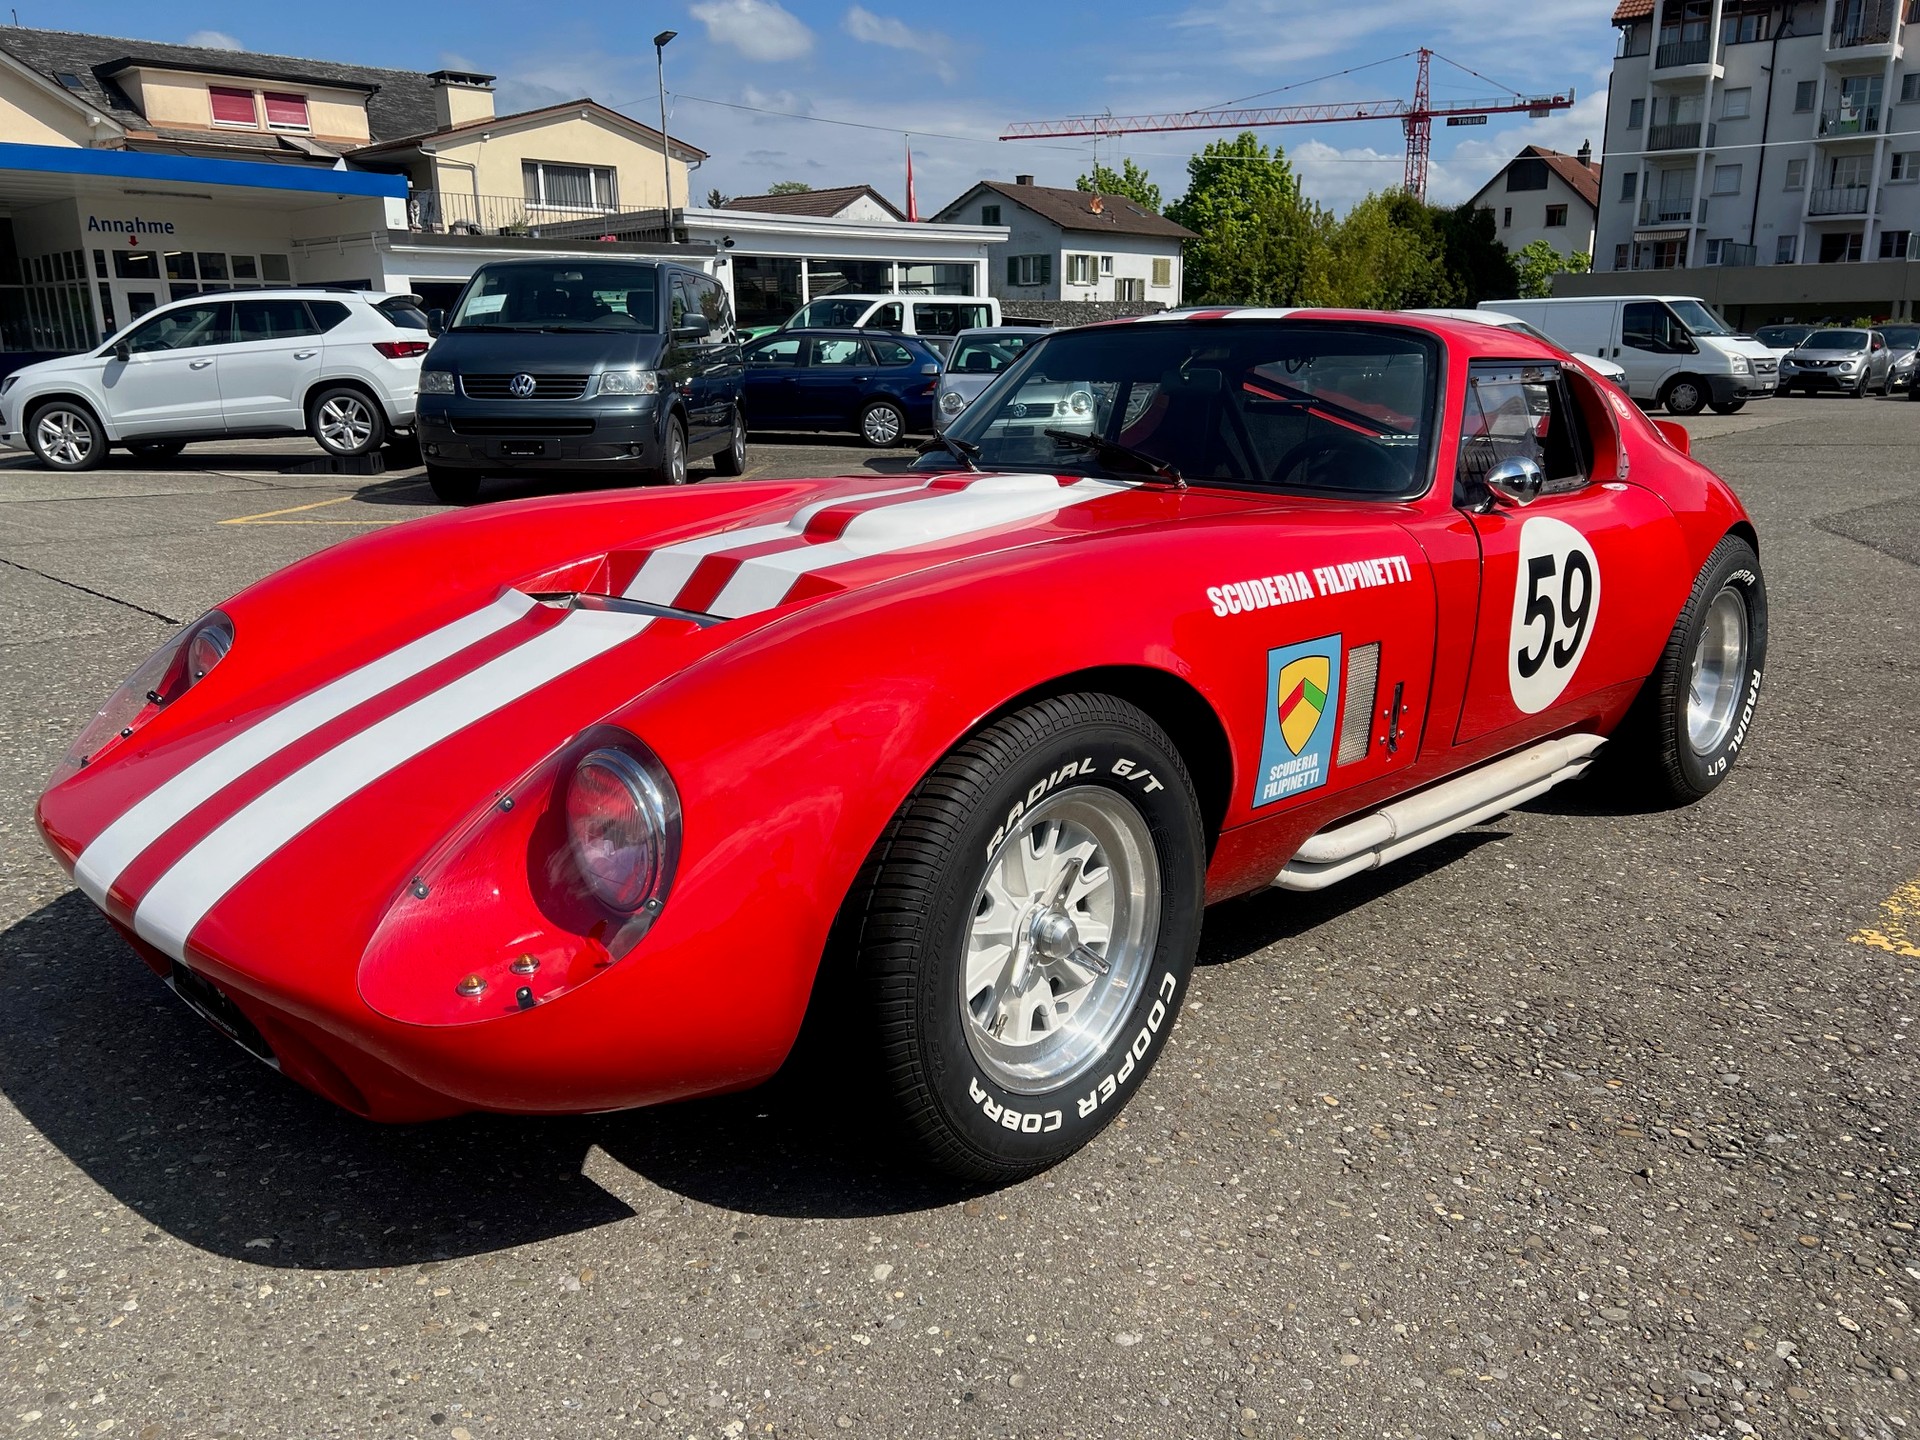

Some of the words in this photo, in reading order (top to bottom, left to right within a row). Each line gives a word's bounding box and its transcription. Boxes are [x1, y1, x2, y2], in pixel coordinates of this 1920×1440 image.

[88, 215, 174, 234] Annahme
[1206, 571, 1315, 617] SCUDERIA
[1312, 555, 1412, 596] FILIPINETTI
[1518, 550, 1592, 678] 59
[1728, 669, 1761, 752] RADIAL
[1263, 768, 1320, 800] FILIPINETTI
[1269, 753, 1318, 781] SCUDERIA
[1707, 757, 1727, 776] G/T
[986, 757, 1097, 862] RADIAL
[1111, 758, 1164, 793] G/T
[1077, 972, 1177, 1119] COOPER
[969, 1077, 1063, 1133] COBRA
